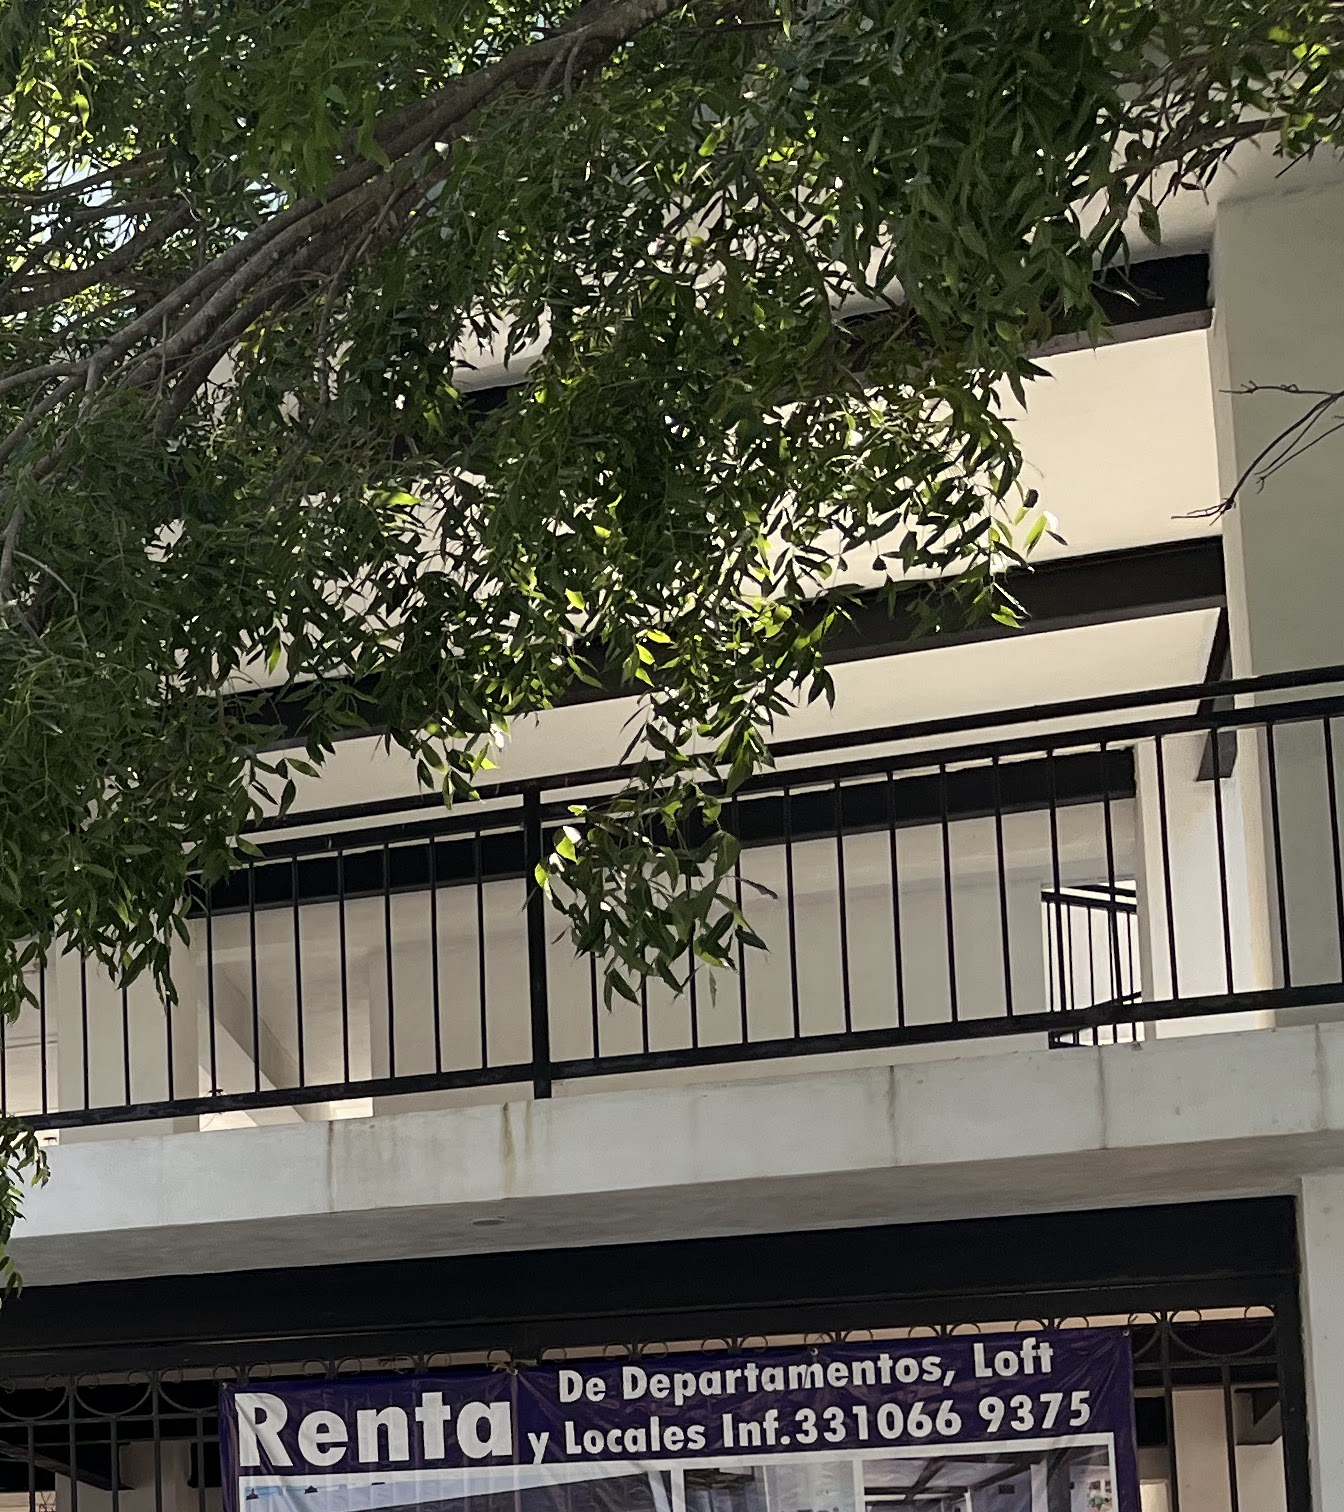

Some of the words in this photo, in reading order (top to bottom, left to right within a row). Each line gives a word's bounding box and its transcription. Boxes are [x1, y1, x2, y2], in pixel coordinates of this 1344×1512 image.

[558, 1369, 606, 1403] De
[622, 1354, 956, 1406] Departamentos,
[973, 1336, 1054, 1378] Loft
[234, 1391, 513, 1467] Renta
[527, 1431, 550, 1465] y
[564, 1415, 707, 1455] Locales
[978, 1390, 1091, 1433] 9375
